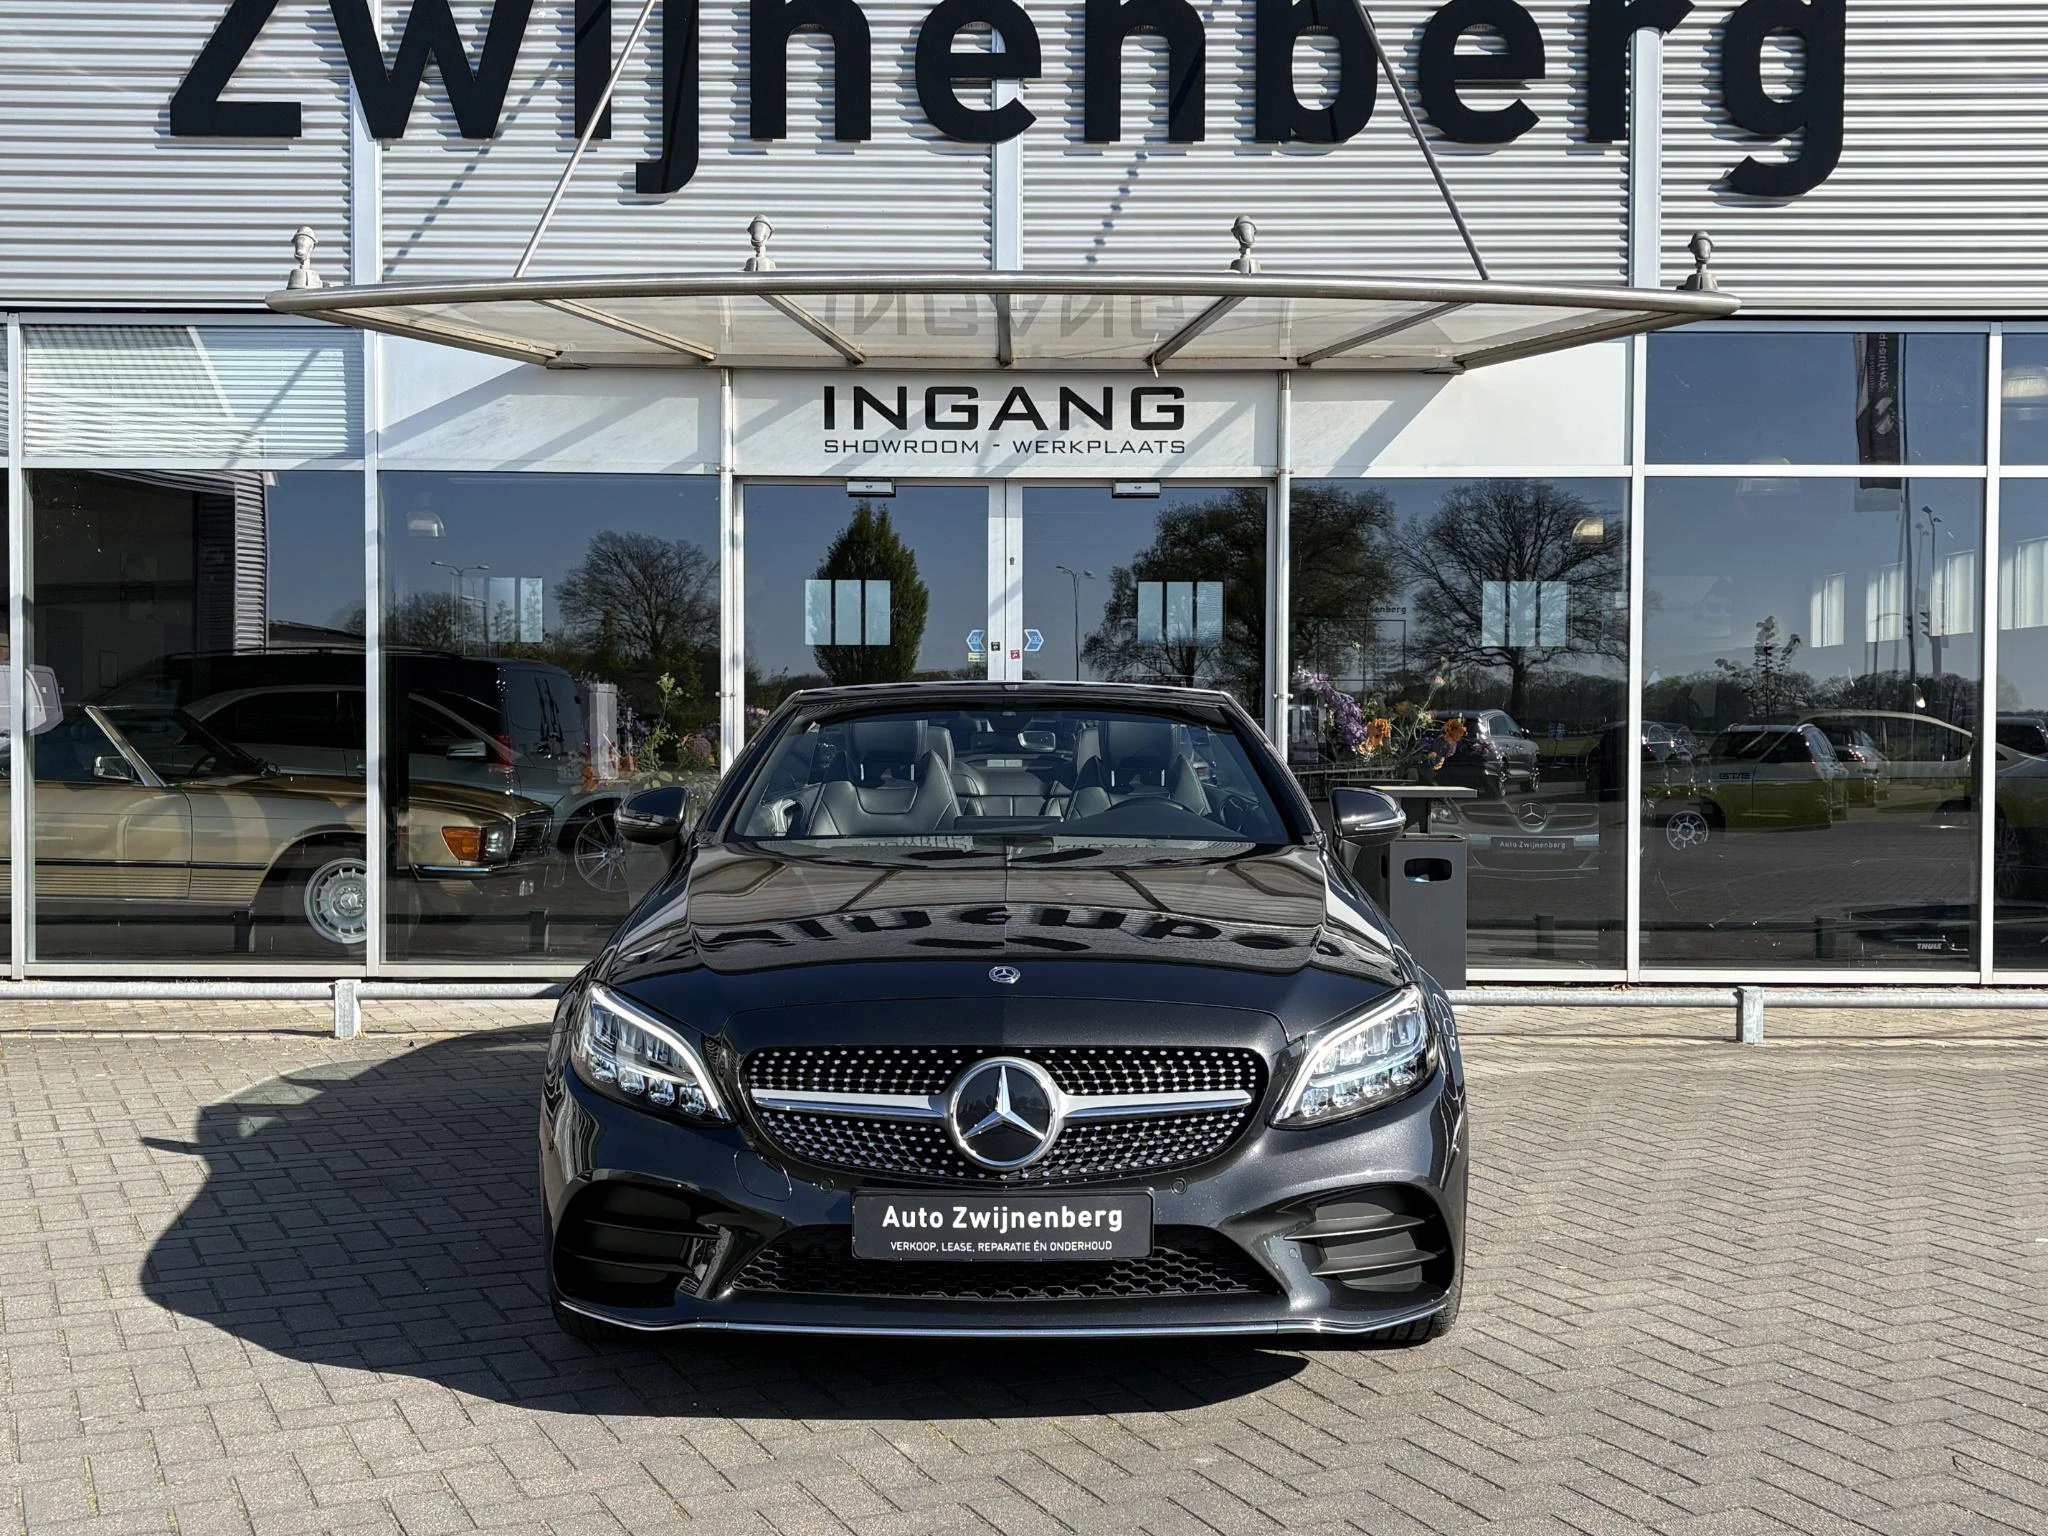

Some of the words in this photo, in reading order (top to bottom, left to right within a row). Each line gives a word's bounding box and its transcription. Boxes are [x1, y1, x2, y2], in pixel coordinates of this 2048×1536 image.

[170, 0, 1847, 197] Zwijnenberg
[824, 386, 1185, 431] INGANG
[824, 439, 979, 454] SHOWROOM
[1013, 440, 1185, 454] WERKPLAATS
[1499, 840, 1517, 849] Auto
[1916, 942, 1943, 950] THULE
[882, 1205, 944, 1229] Auto
[952, 1205, 1123, 1234] Zwijnenberg
[890, 1241, 939, 1253] VERKOOP,
[941, 1242, 975, 1253] LEASE,
[977, 1241, 1031, 1252] REPARATIE
[1049, 1240, 1113, 1252] ONDERHOUD
